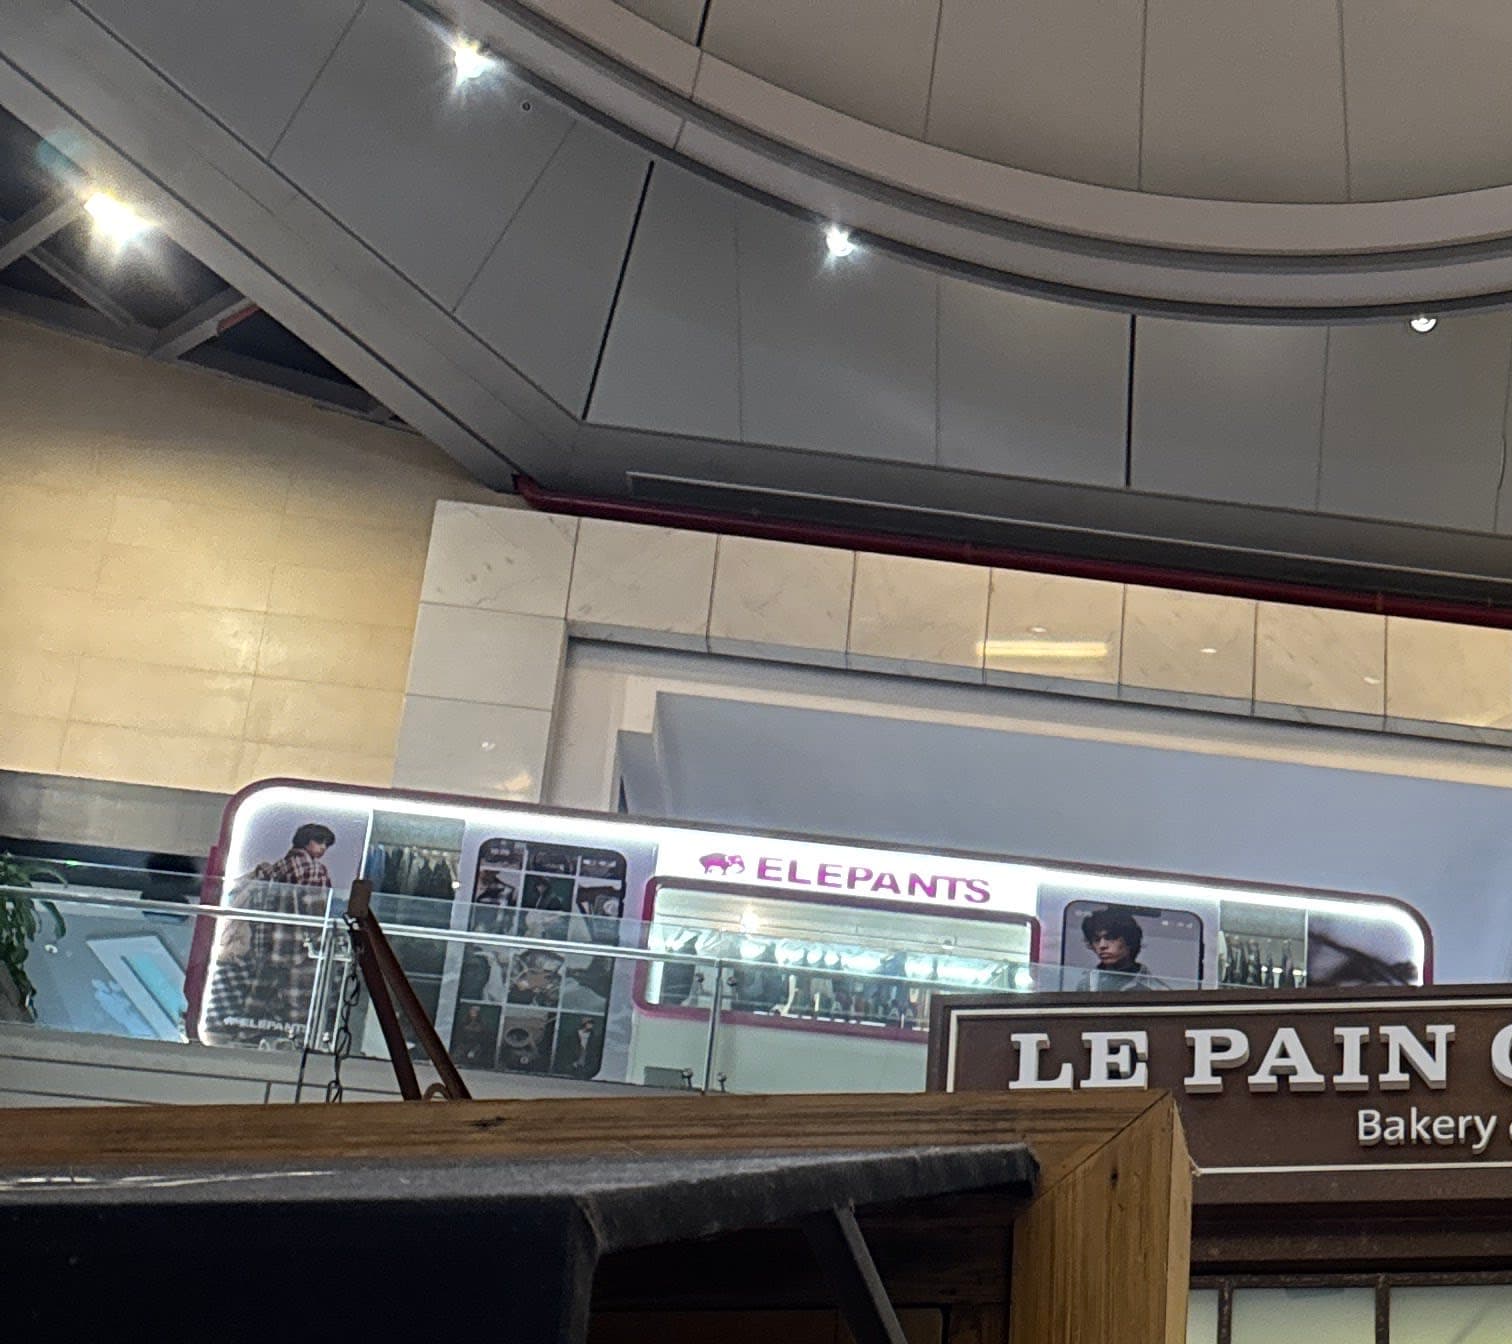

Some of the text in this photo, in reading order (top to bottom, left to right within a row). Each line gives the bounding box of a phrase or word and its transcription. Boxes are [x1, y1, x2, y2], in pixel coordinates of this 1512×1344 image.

[757, 856, 990, 904] ELEPANTS
[1007, 1030, 1150, 1090] LE
[1184, 1023, 1456, 1094] PAIN
[1357, 1105, 1498, 1155] Bakery
